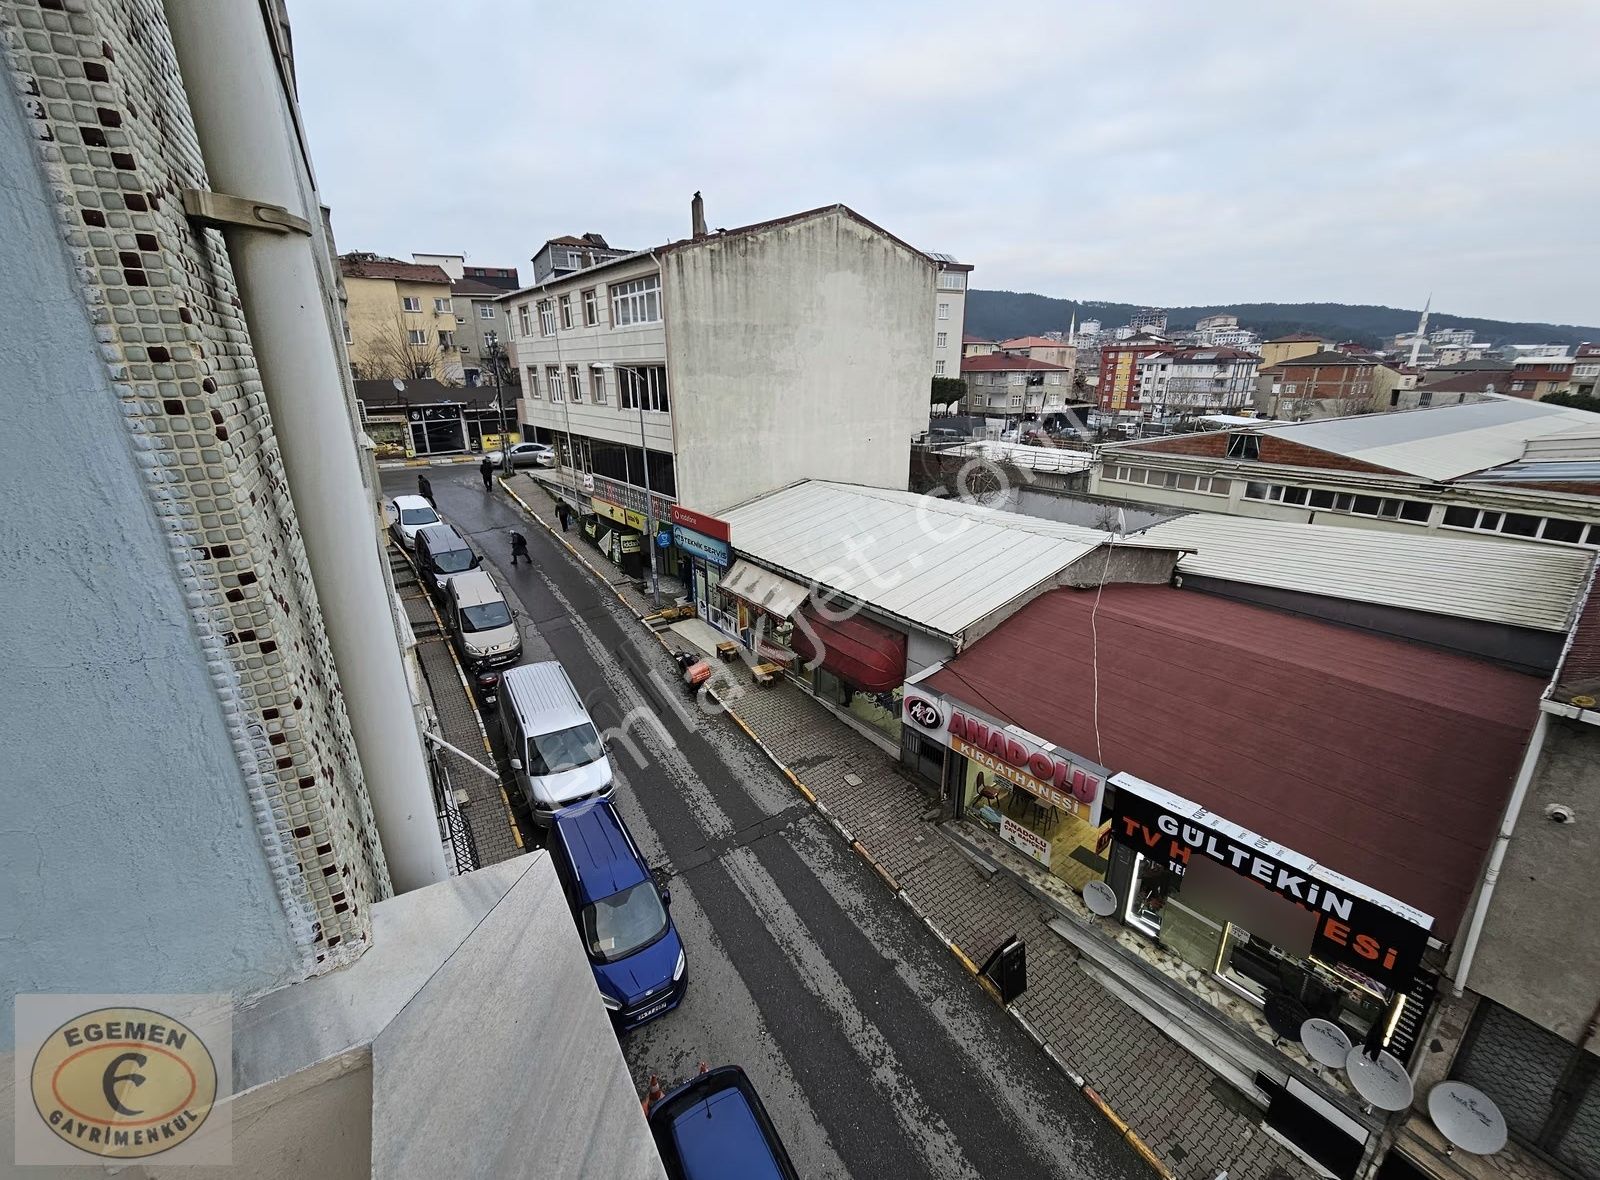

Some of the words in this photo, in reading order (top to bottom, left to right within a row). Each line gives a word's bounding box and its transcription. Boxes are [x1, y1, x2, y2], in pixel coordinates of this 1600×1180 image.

[947, 711, 1100, 804] ANADOLU
[1004, 819, 1047, 848] ANADOLU
[1122, 815, 1163, 847] TV
